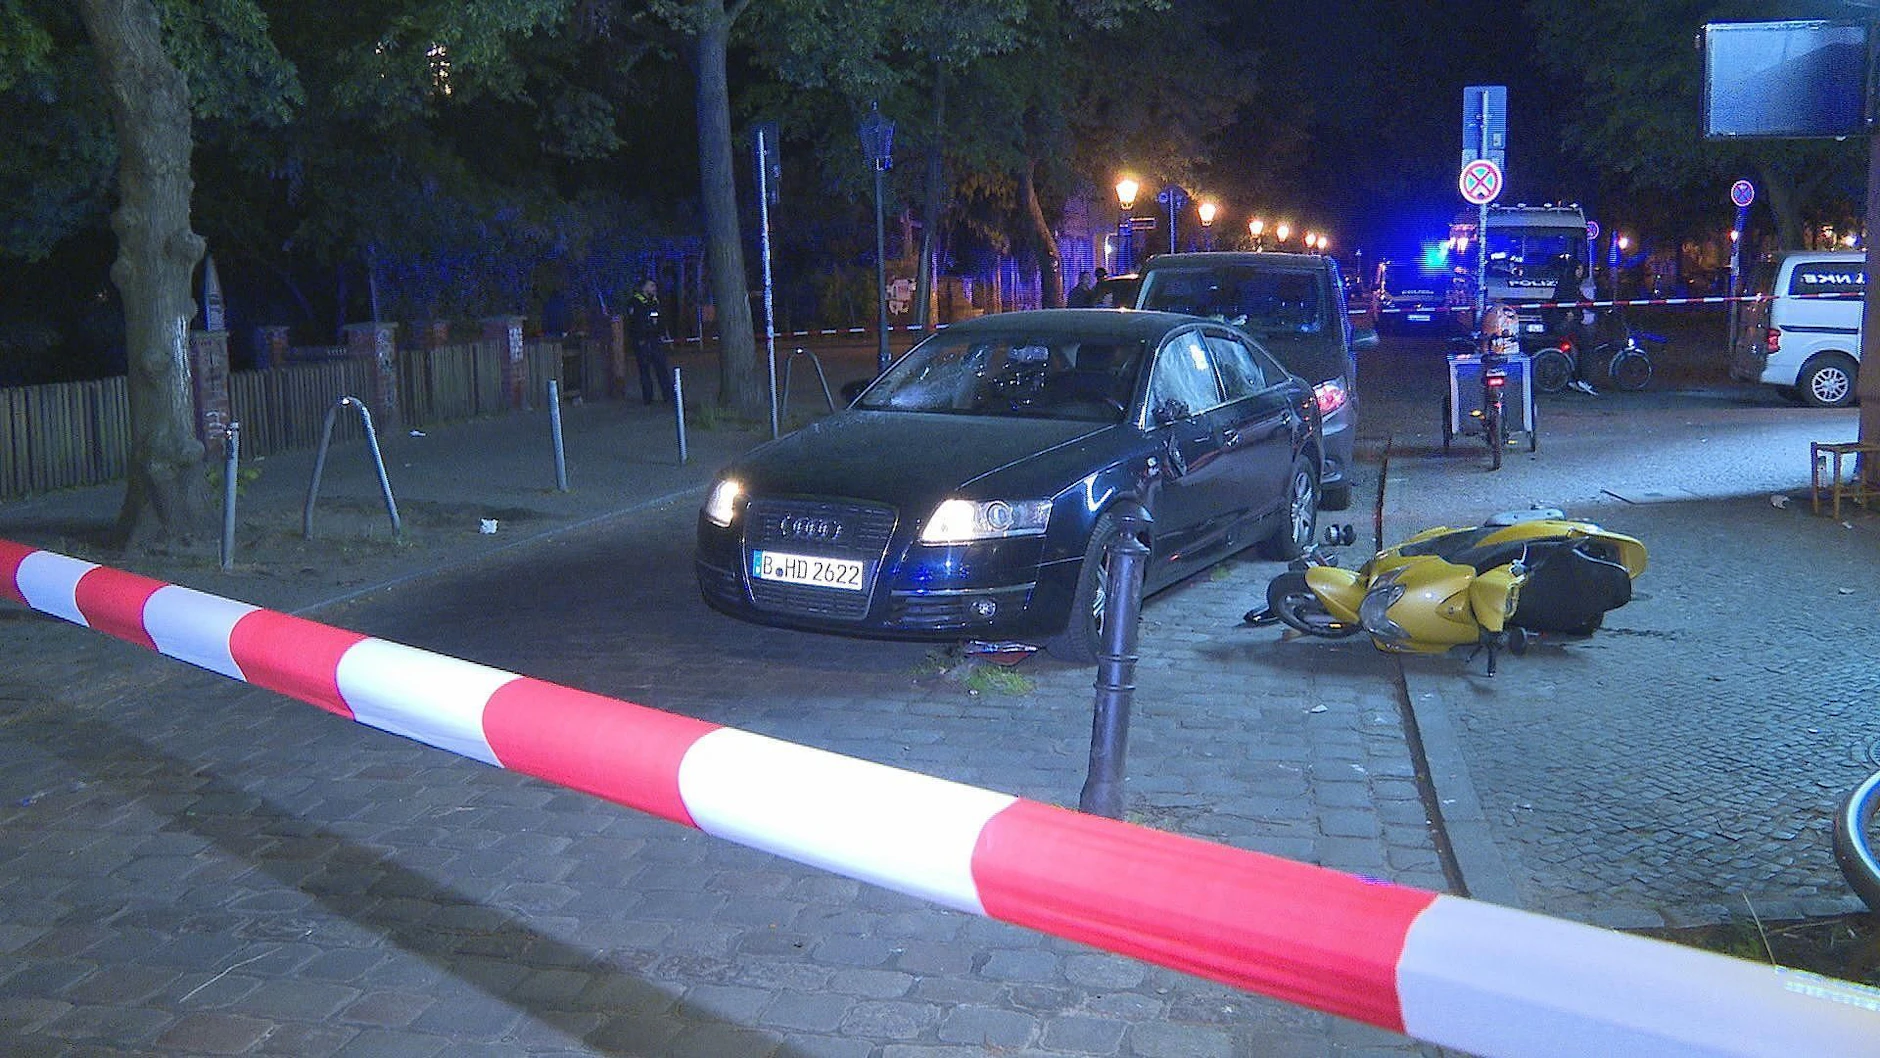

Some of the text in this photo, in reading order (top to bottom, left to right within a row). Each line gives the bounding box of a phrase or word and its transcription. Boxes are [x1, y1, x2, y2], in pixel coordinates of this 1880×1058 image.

[763, 555, 773, 575] B
[785, 558, 808, 579] HD
[812, 561, 860, 586] 2622
